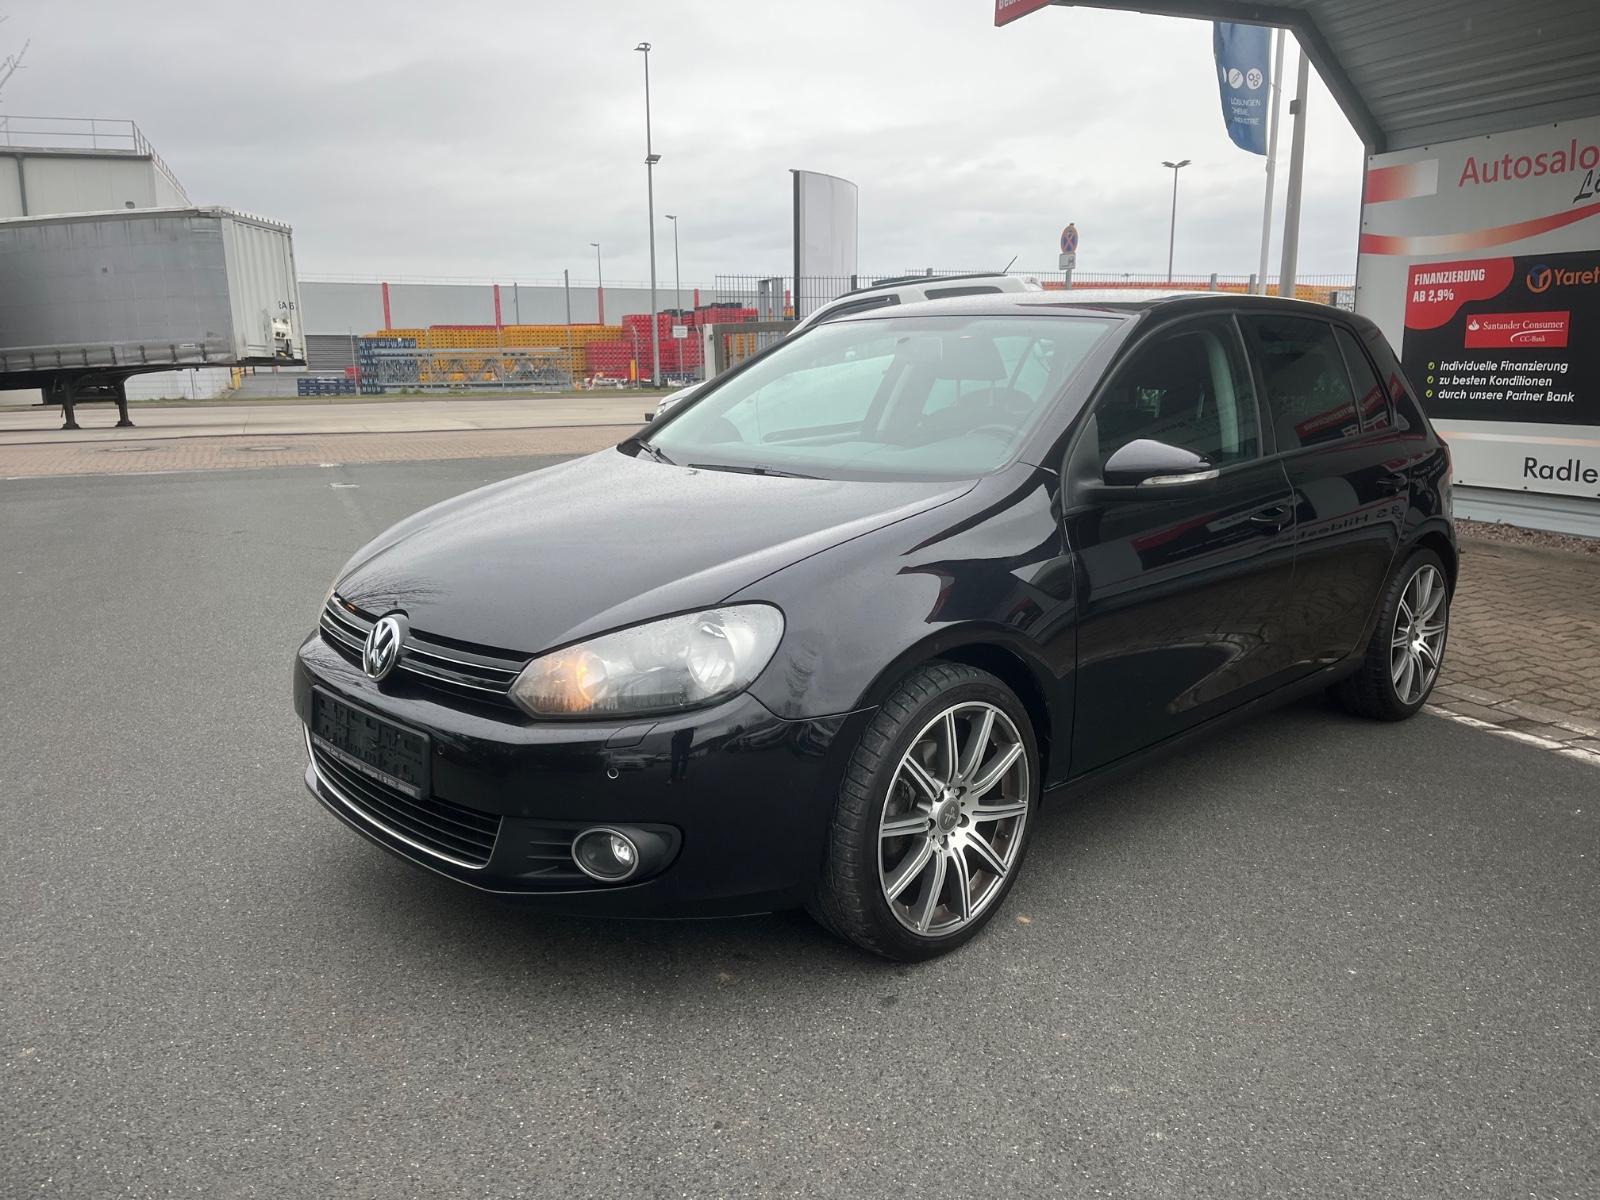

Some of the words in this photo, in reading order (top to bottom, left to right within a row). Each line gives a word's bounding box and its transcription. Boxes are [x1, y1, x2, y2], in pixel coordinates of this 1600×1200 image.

[1458, 138, 1600, 187] Autosalo
[1414, 268, 1486, 286] FINANZIERUNG
[1412, 290, 1426, 303] AB
[1428, 289, 1454, 303] 2,9%
[1483, 320, 1521, 330] Santander
[1522, 320, 1565, 329] Consumer
[1519, 335, 1546, 343] CC-Bank
[1440, 360, 1498, 371] individuelle
[1500, 360, 1569, 374] Finanzierung
[1439, 375, 1450, 385] zu
[1452, 375, 1487, 386] besten
[1489, 375, 1553, 387] Konditionen
[1438, 389, 1467, 400] durch
[1469, 390, 1504, 400] unsere
[1505, 390, 1544, 402] Partner
[1546, 391, 1576, 403] Bank
[1523, 456, 1599, 484] Radle
